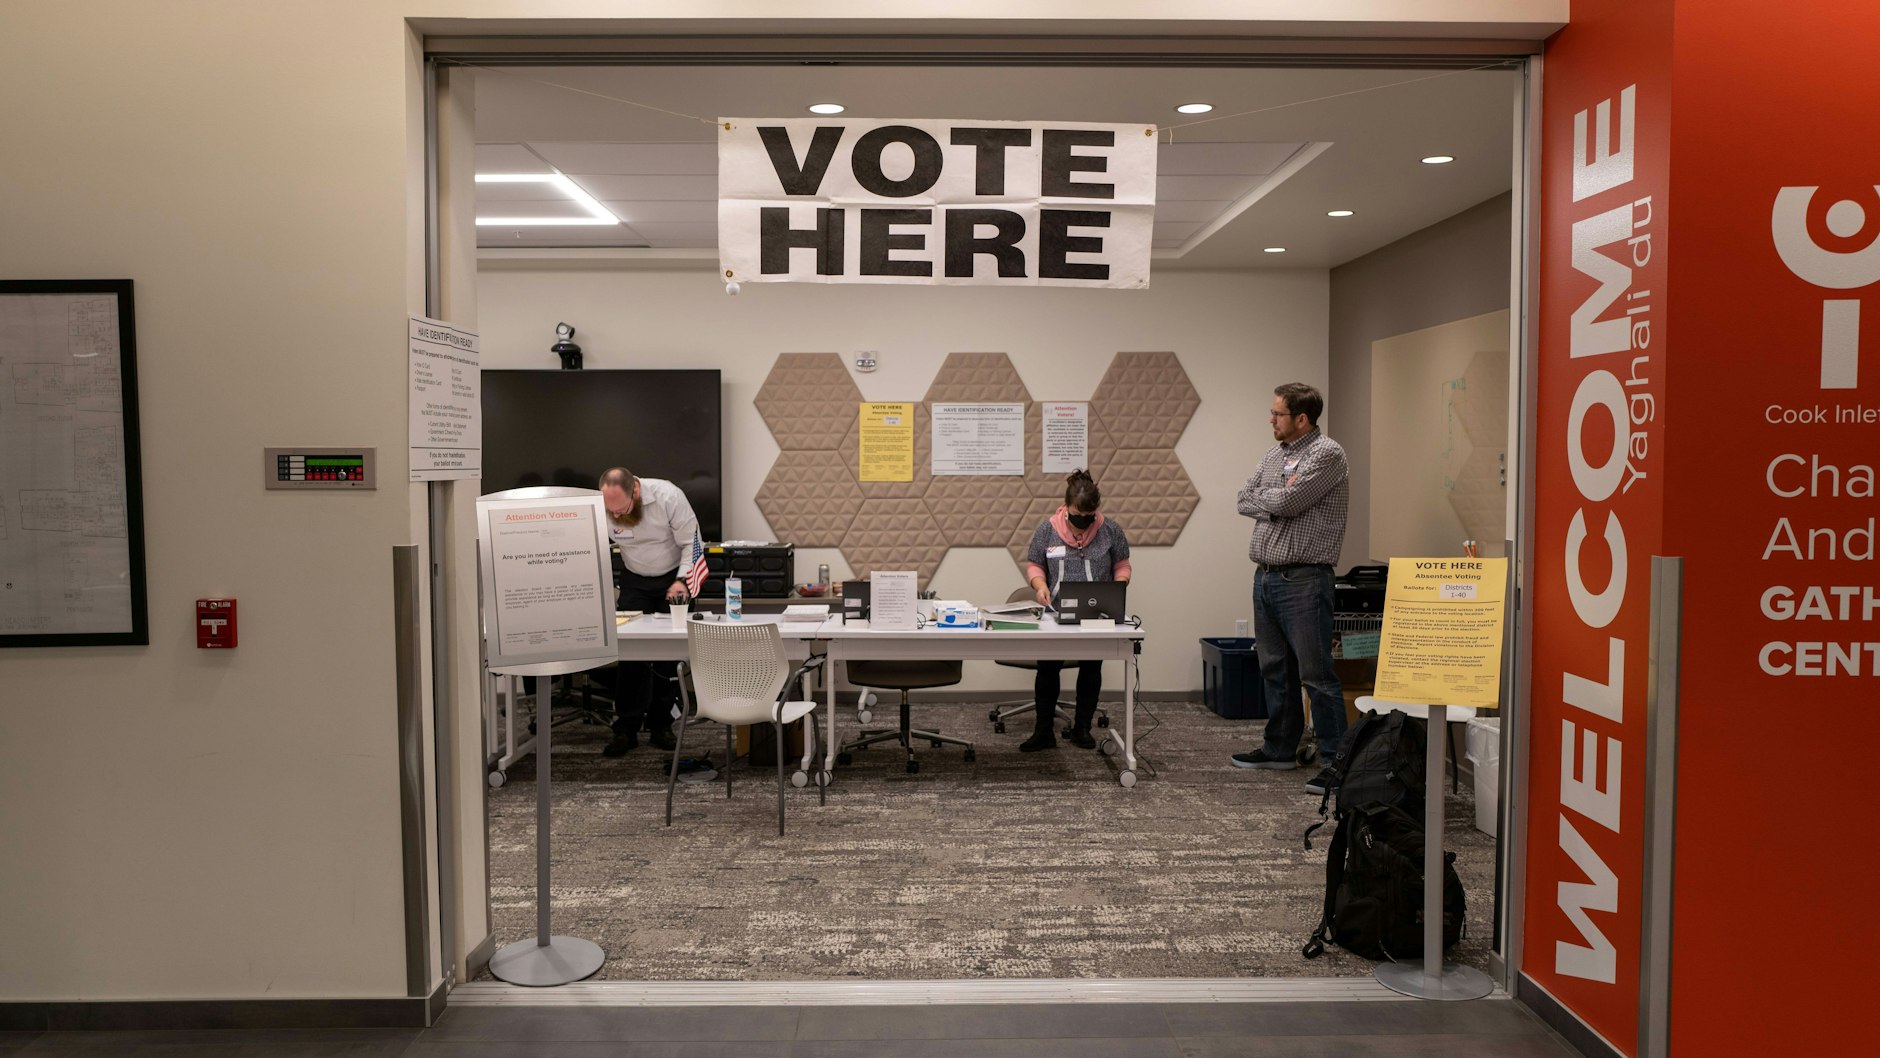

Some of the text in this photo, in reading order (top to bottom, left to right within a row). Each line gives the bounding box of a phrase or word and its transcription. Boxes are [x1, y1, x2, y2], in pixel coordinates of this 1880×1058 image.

[756, 125, 1115, 200] VOTE
[760, 206, 1112, 280] HERE
[418, 327, 428, 338] HAVE
[1622, 195, 1656, 495] Yaghali du
[1764, 404, 1828, 424] Cook
[1766, 453, 1875, 498] Cha
[505, 512, 547, 521] Attention
[1554, 83, 1636, 985] WELCOME
[1761, 517, 1876, 561] And
[1760, 585, 1880, 621] GATH
[1758, 640, 1880, 677] CENT
